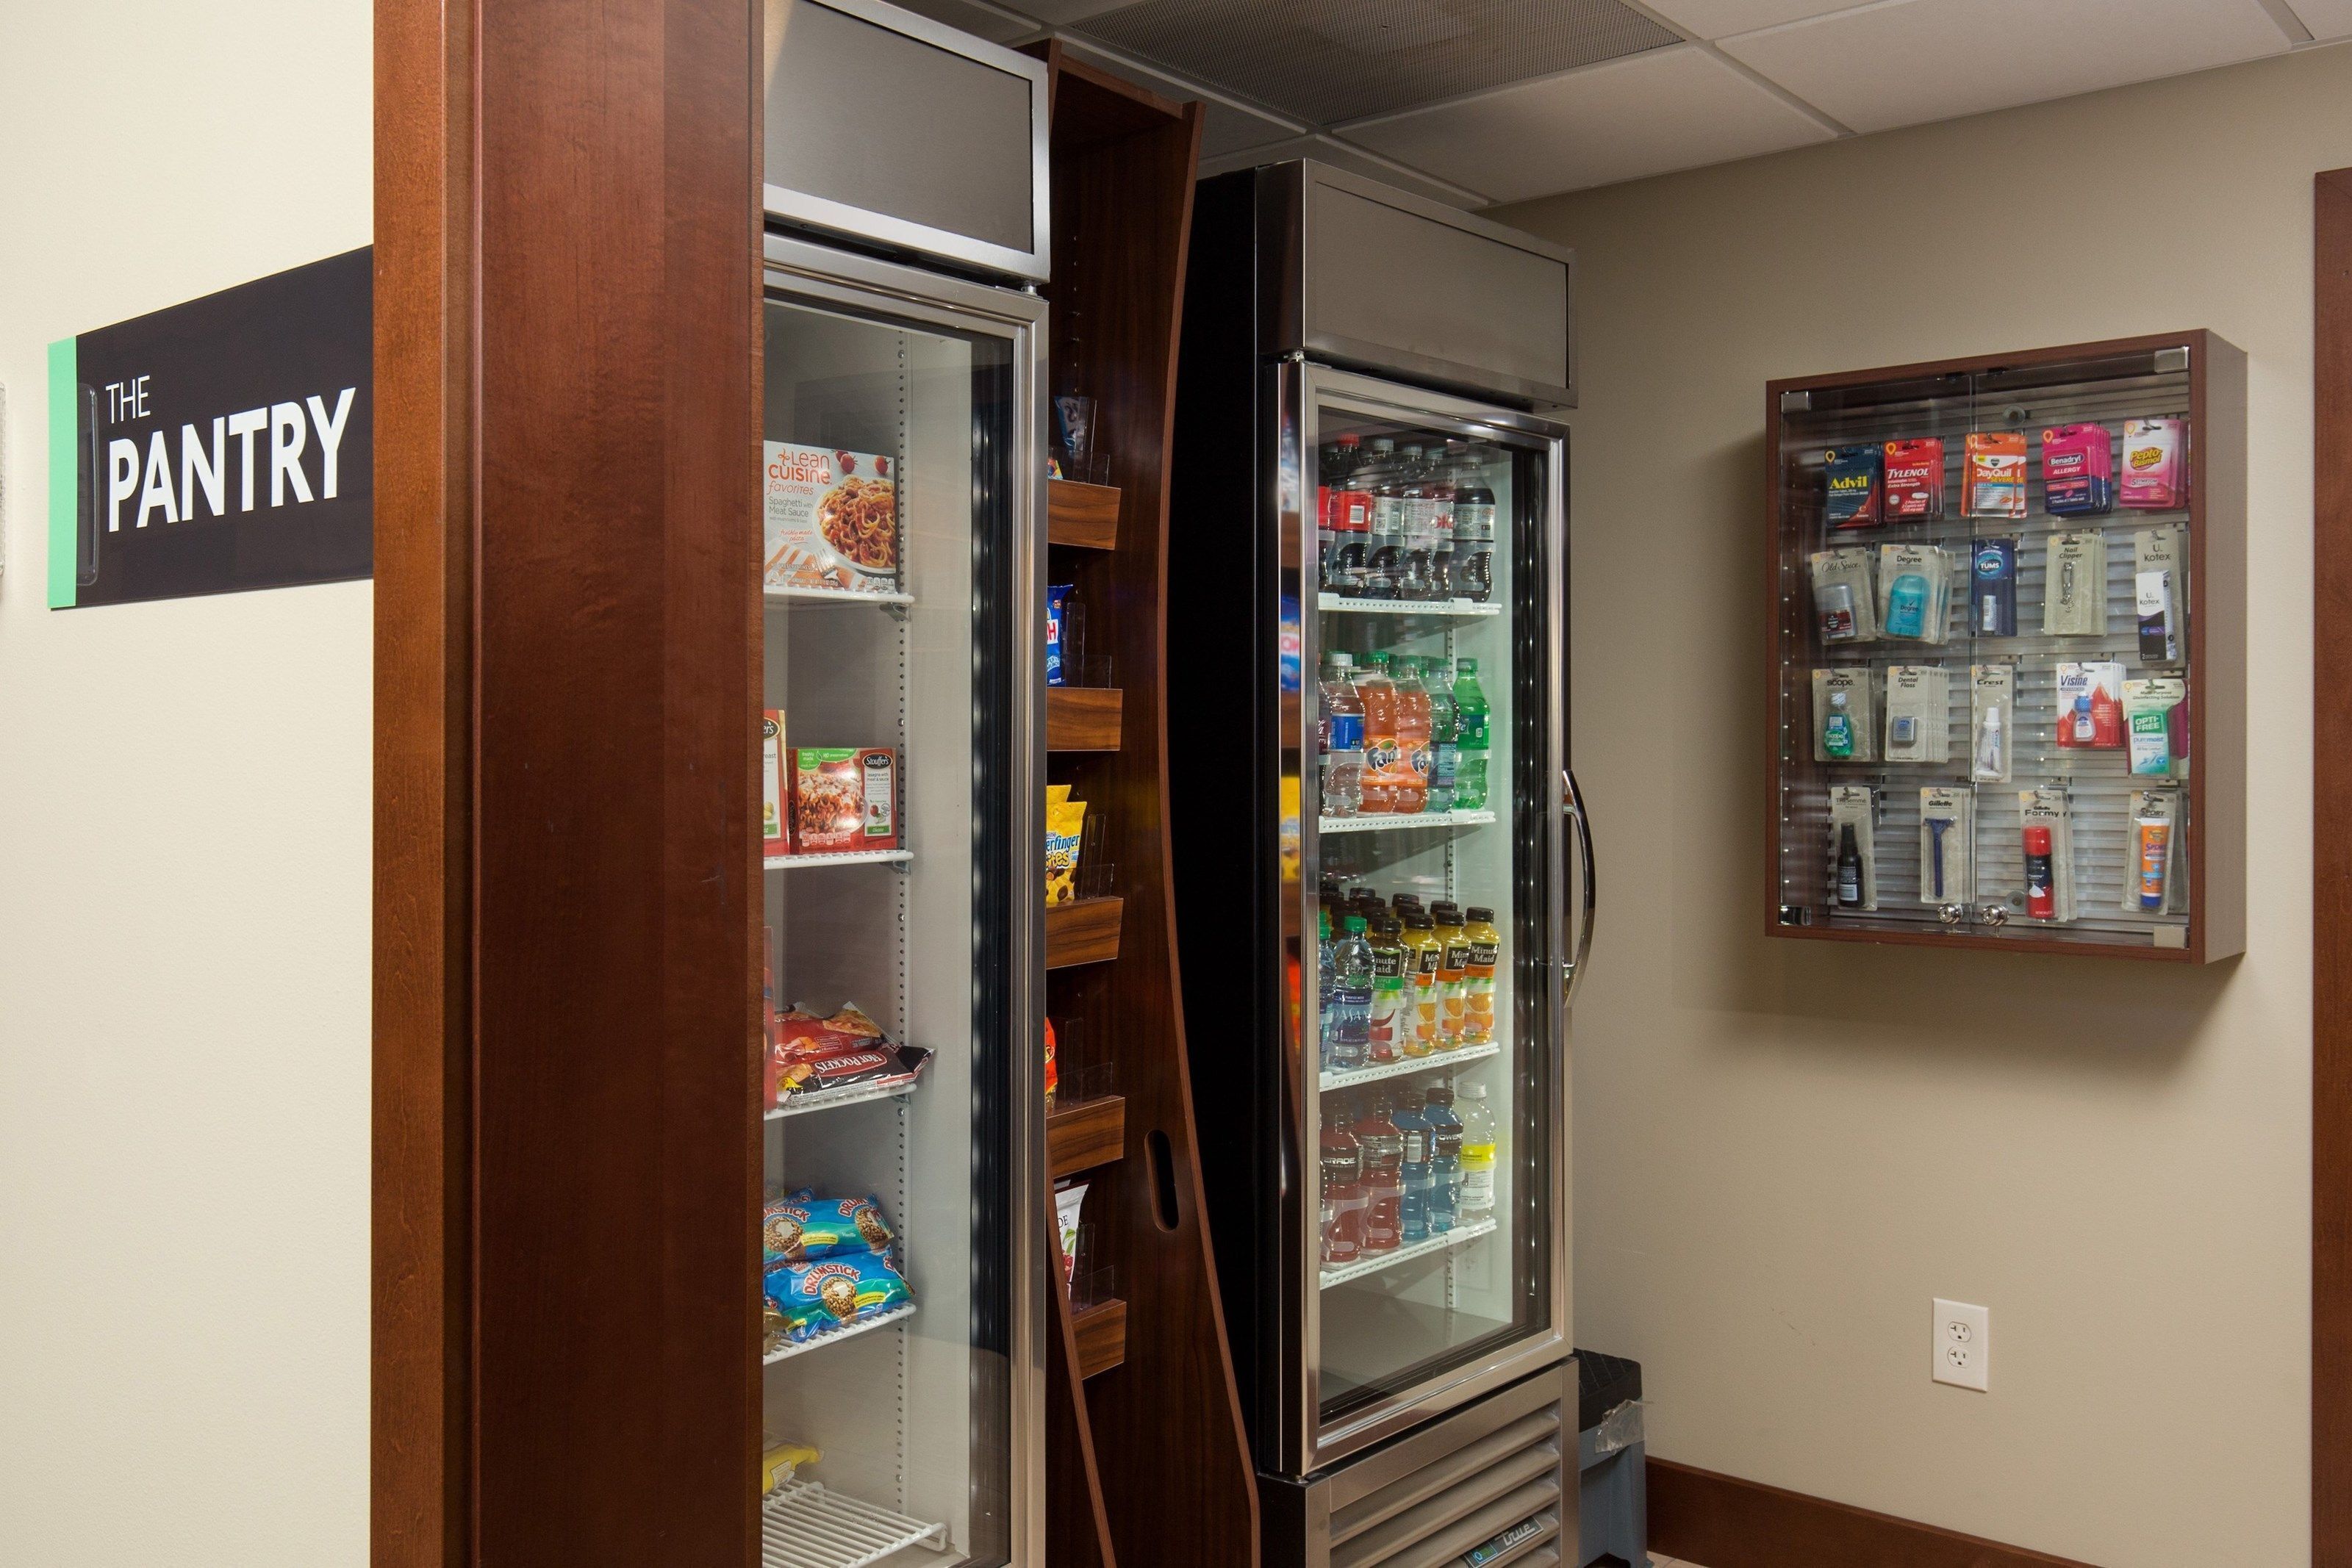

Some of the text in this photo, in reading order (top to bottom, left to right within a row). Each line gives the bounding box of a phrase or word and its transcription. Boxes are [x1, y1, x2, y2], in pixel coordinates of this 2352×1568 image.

[106, 375, 151, 423] THE
[109, 387, 356, 533] PANTRY
[792, 451, 830, 469] Lean
[2051, 455, 2082, 465] Benadryl
[1887, 468, 1929, 479] TYLENOL
[1976, 468, 2012, 479] DayQuil
[2053, 467, 2081, 475] ALLERGY
[1829, 475, 1868, 489] Advil
[766, 481, 814, 495] favorites
[769, 496, 803, 508] Spaghetti
[769, 506, 809, 517] Meat Sauce
[1896, 555, 1922, 564] Degree
[1821, 560, 1859, 572] Old Spice
[1826, 678, 1854, 688] scope
[2061, 675, 2088, 686] Visine
[2136, 722, 2160, 732] FREE
[866, 755, 889, 766] Stouffer's
[1046, 835, 1080, 852] erfinger
[1047, 852, 1070, 867] ites
[1474, 954, 1495, 963] Maid
[1376, 964, 1391, 974] aid
[1333, 1007, 1369, 1023] DASAN
[1324, 1156, 1357, 1165] ERADE
[804, 1264, 860, 1295] DRUMSTICK
